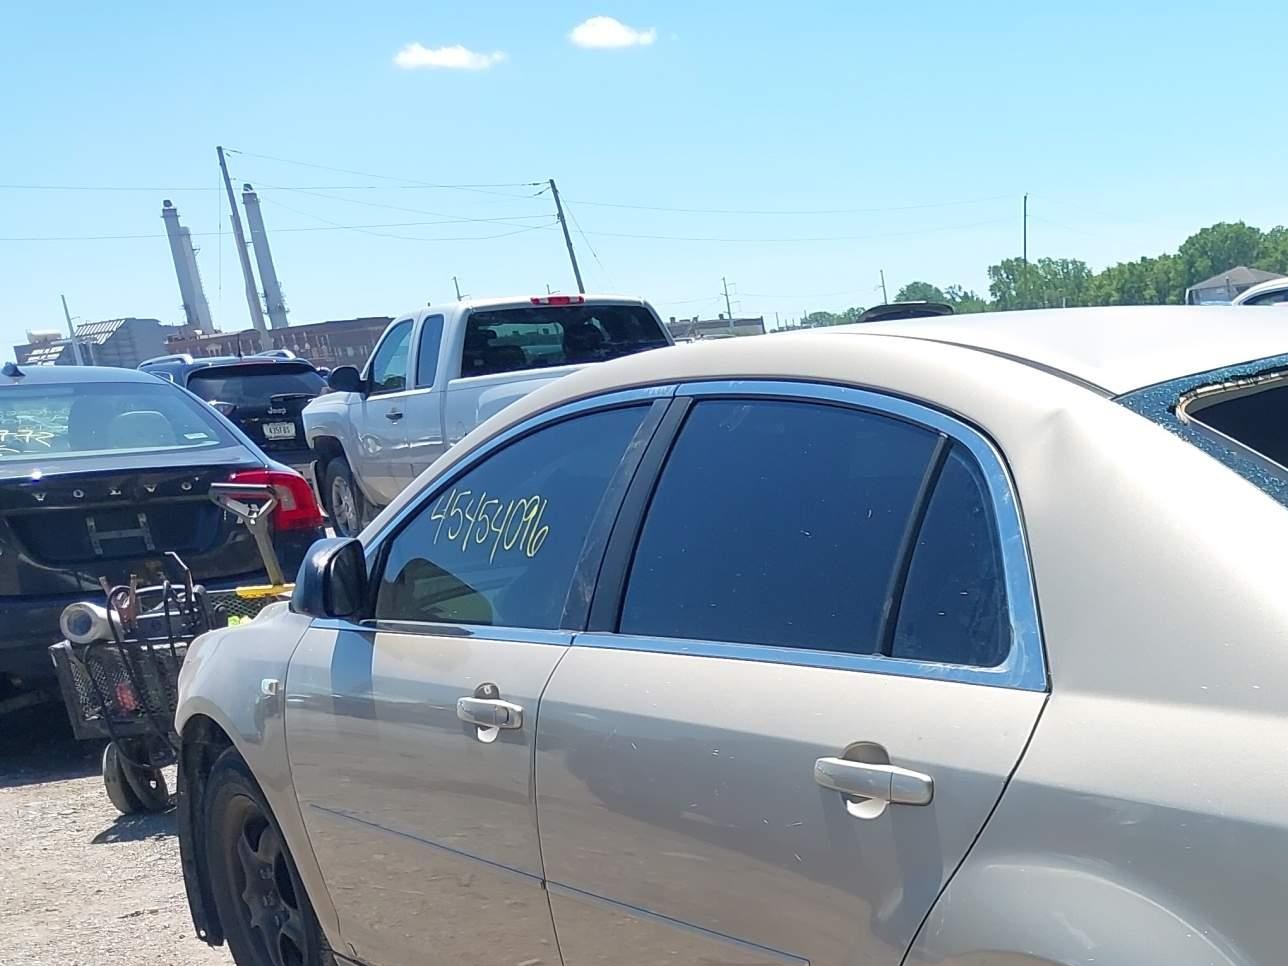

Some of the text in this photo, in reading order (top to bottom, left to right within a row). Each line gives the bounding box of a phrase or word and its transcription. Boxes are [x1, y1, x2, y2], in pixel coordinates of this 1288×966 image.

[267, 407, 287, 415] Jeep
[32, 481, 193, 501] VOLVO
[430, 488, 550, 566] 45454096
